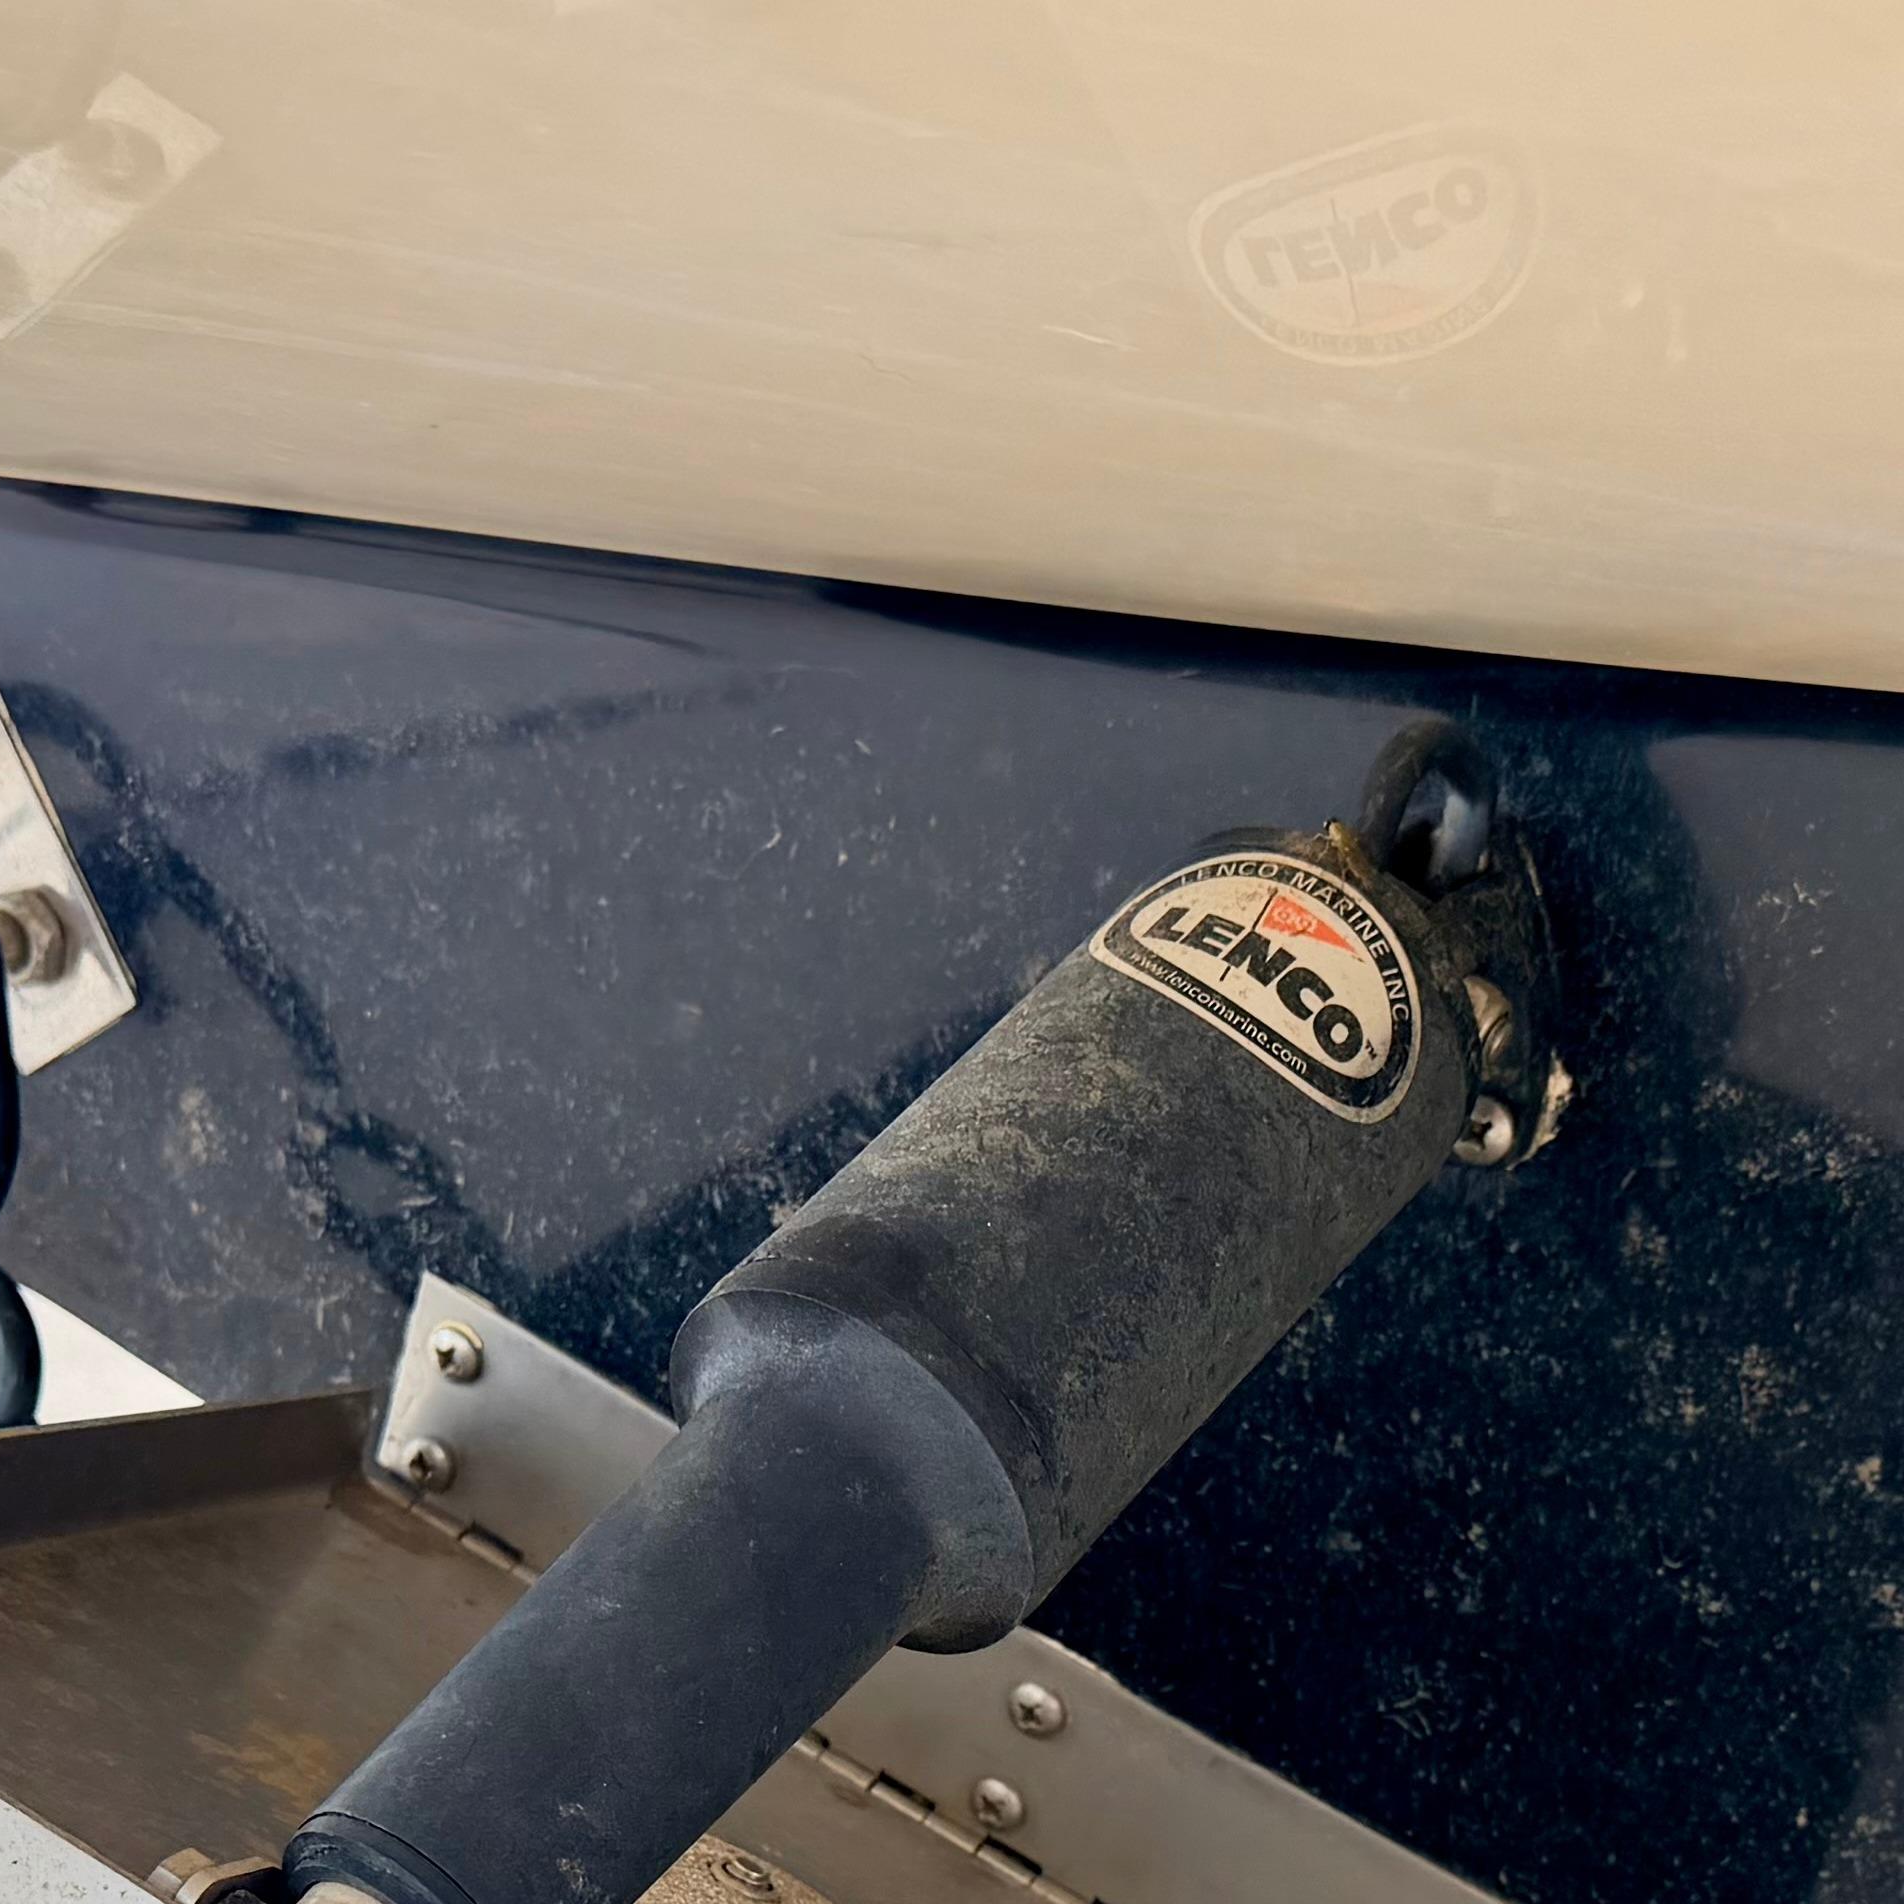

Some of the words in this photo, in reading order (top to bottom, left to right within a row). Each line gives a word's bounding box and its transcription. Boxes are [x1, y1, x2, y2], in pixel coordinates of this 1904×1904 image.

[1142, 906, 1364, 1064] LENCO
[1180, 861, 1280, 886] LENCO
[1291, 870, 1391, 959] MARINE
[1381, 967, 1411, 1022] INC
